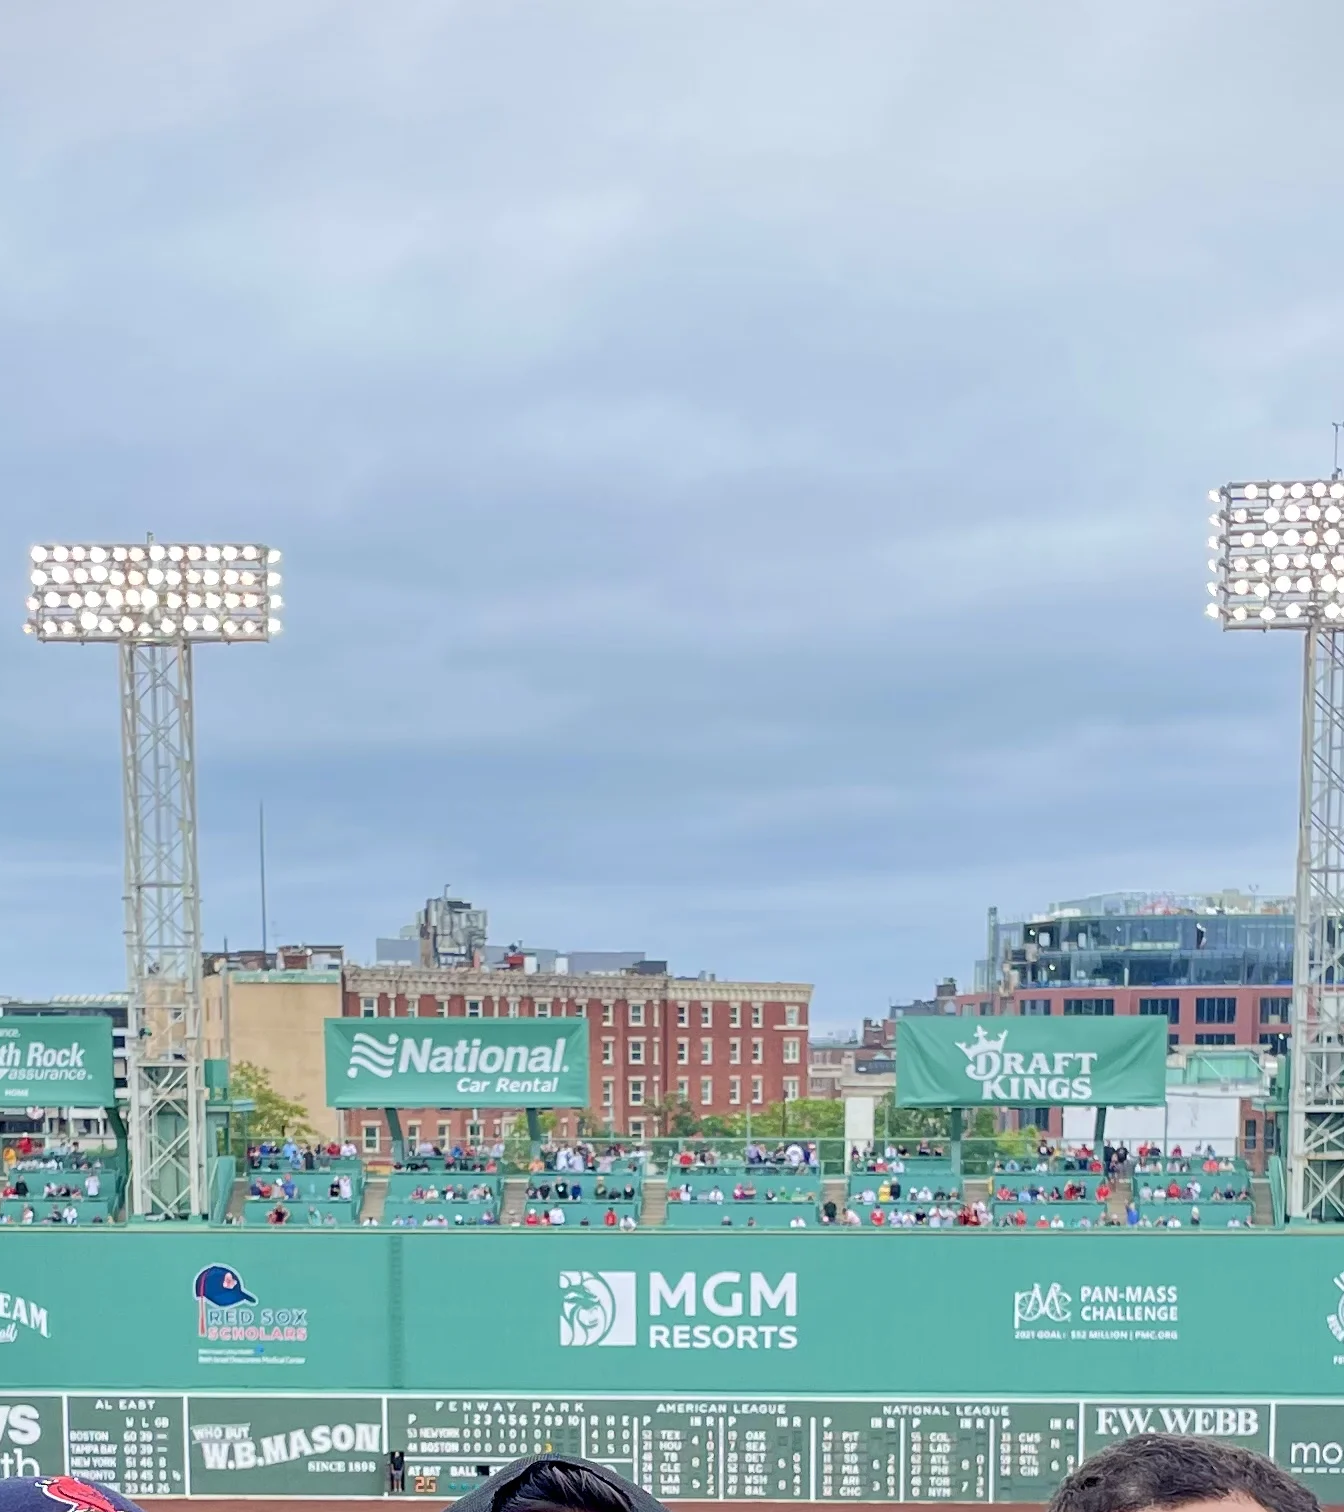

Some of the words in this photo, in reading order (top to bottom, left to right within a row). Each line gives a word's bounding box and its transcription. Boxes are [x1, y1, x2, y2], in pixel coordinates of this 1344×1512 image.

[27, 1042, 85, 1067] Rock
[965, 1051, 1098, 1081] DRAFT
[7, 1067, 87, 1080] assurance
[456, 1078, 491, 1092] Car
[495, 1077, 559, 1093] Rental
[981, 1076, 1092, 1100] KINGS
[4, 1088, 29, 1097] HOME
[648, 1271, 798, 1317] MGM
[1080, 1285, 1178, 1303] PAN-MASS
[207, 1308, 255, 1326] RED
[260, 1308, 308, 1326] SOX
[1080, 1305, 1178, 1321] CHALLENGE
[207, 1326, 308, 1340] SCHOLARS
[648, 1325, 798, 1349] RESORTS
[1089, 1330, 1128, 1339] MILLION
[95, 1399, 113, 1410] AL
[118, 1399, 155, 1410] EAST
[435, 1402, 517, 1412] FENWAY
[532, 1402, 584, 1412] PARK
[656, 1403, 727, 1414] AMERICAN
[733, 1403, 787, 1415] LEAGUE
[882, 1405, 950, 1415] NATIONAL
[955, 1405, 1010, 1416] LEAGUE
[590, 1415, 599, 1426] R
[606, 1415, 615, 1426] H
[1095, 1408, 1156, 1436] F.W.
[1159, 1408, 1258, 1436] WEBB
[70, 1430, 109, 1442] BOSTON
[192, 1426, 222, 1440] WHO
[225, 1425, 249, 1439] BUT
[70, 1443, 99, 1455] TAMPA
[99, 1443, 118, 1455] BAY
[201, 1422, 382, 1470] W.B.MASON
[420, 1442, 459, 1453] BOSTON
[70, 1456, 91, 1468] NEW
[91, 1456, 117, 1468] YORK
[307, 1460, 346, 1472] SINCE
[70, 1469, 116, 1481] TORONTO
[408, 1466, 422, 1477] AT
[423, 1466, 441, 1477] BAT
[450, 1465, 477, 1477] BALL
[415, 1476, 437, 1493] 25
